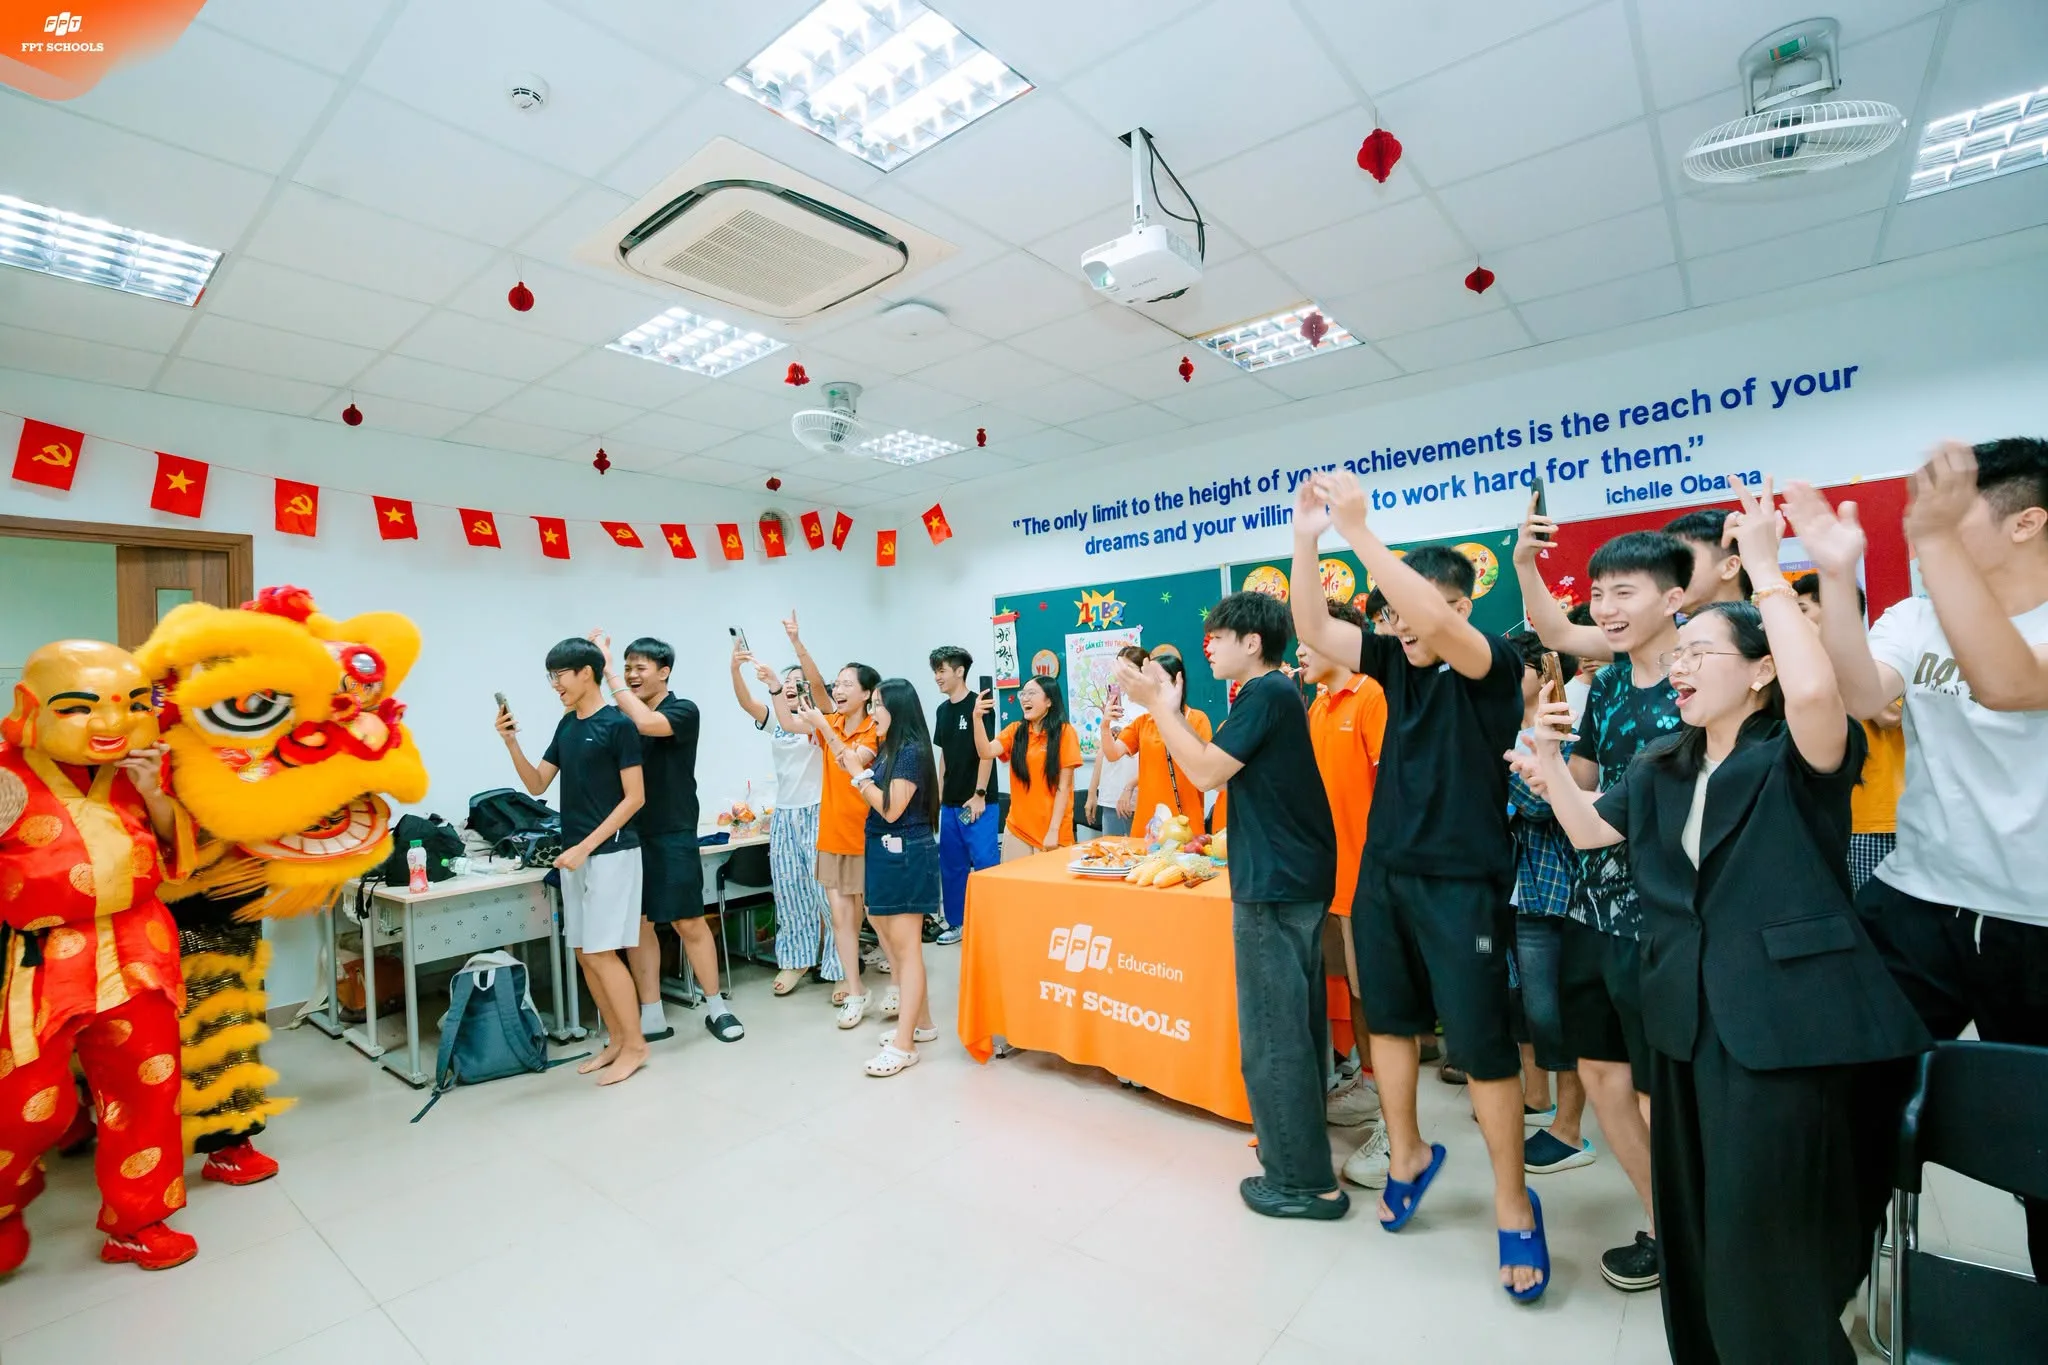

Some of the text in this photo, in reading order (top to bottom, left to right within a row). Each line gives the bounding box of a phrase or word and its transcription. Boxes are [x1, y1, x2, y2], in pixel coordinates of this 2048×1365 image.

[1053, 509, 1088, 531] only
[1092, 499, 1128, 523] limit
[1131, 497, 1150, 516] to
[1154, 491, 1184, 511] the
[1189, 475, 1252, 506] height
[1257, 469, 1280, 493] of
[1343, 426, 1523, 476] achievements
[1529, 419, 1553, 445] is
[1561, 411, 1610, 438] the
[1619, 388, 1712, 429] reach
[1720, 377, 1757, 410] of
[1770, 365, 1859, 409] your
[1085, 530, 1150, 555] dreams
[1153, 519, 1187, 545] and
[1192, 515, 1237, 543] your
[1371, 488, 1397, 511] to
[1402, 474, 1468, 506] work
[1474, 461, 1537, 495] hard
[1546, 457, 1589, 484] for
[1601, 434, 1704, 474] them.”
[1606, 477, 1673, 505] ichelle
[1080, 600, 1124, 627] 11B2
[1048, 923, 1183, 983] FPT Education
[1039, 980, 1191, 1041] FPT SCHOOLS
